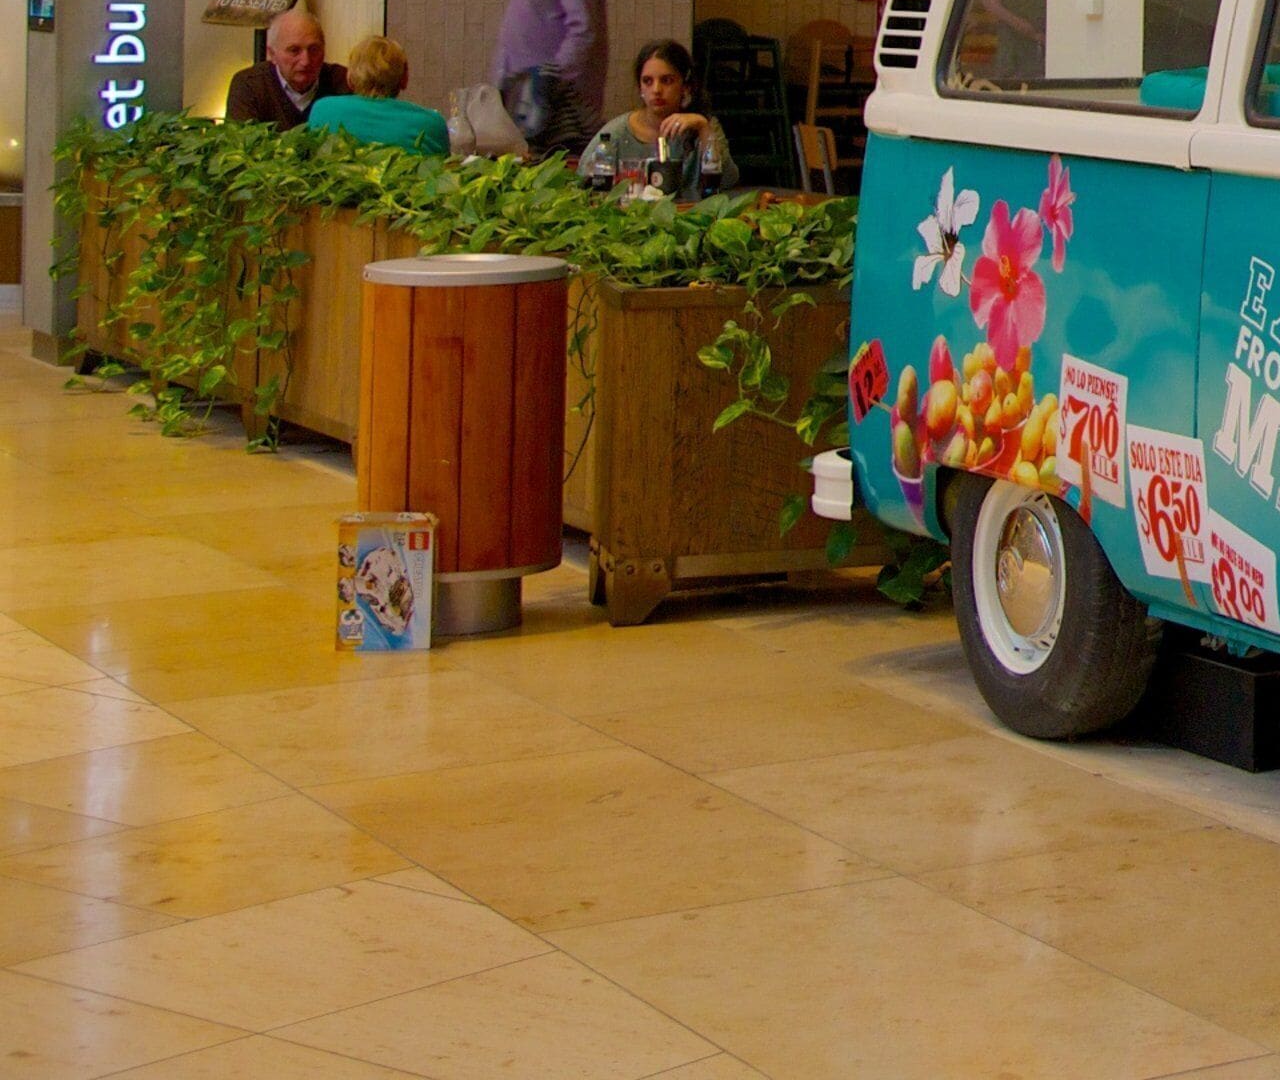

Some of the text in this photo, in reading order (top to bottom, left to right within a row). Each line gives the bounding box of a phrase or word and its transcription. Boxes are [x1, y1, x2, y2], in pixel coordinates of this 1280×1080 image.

[101, 78, 145, 130] et
[1077, 370, 1086, 389] LO
[1130, 440, 1156, 473] SOLO
[1158, 448, 1183, 478] ESTE
